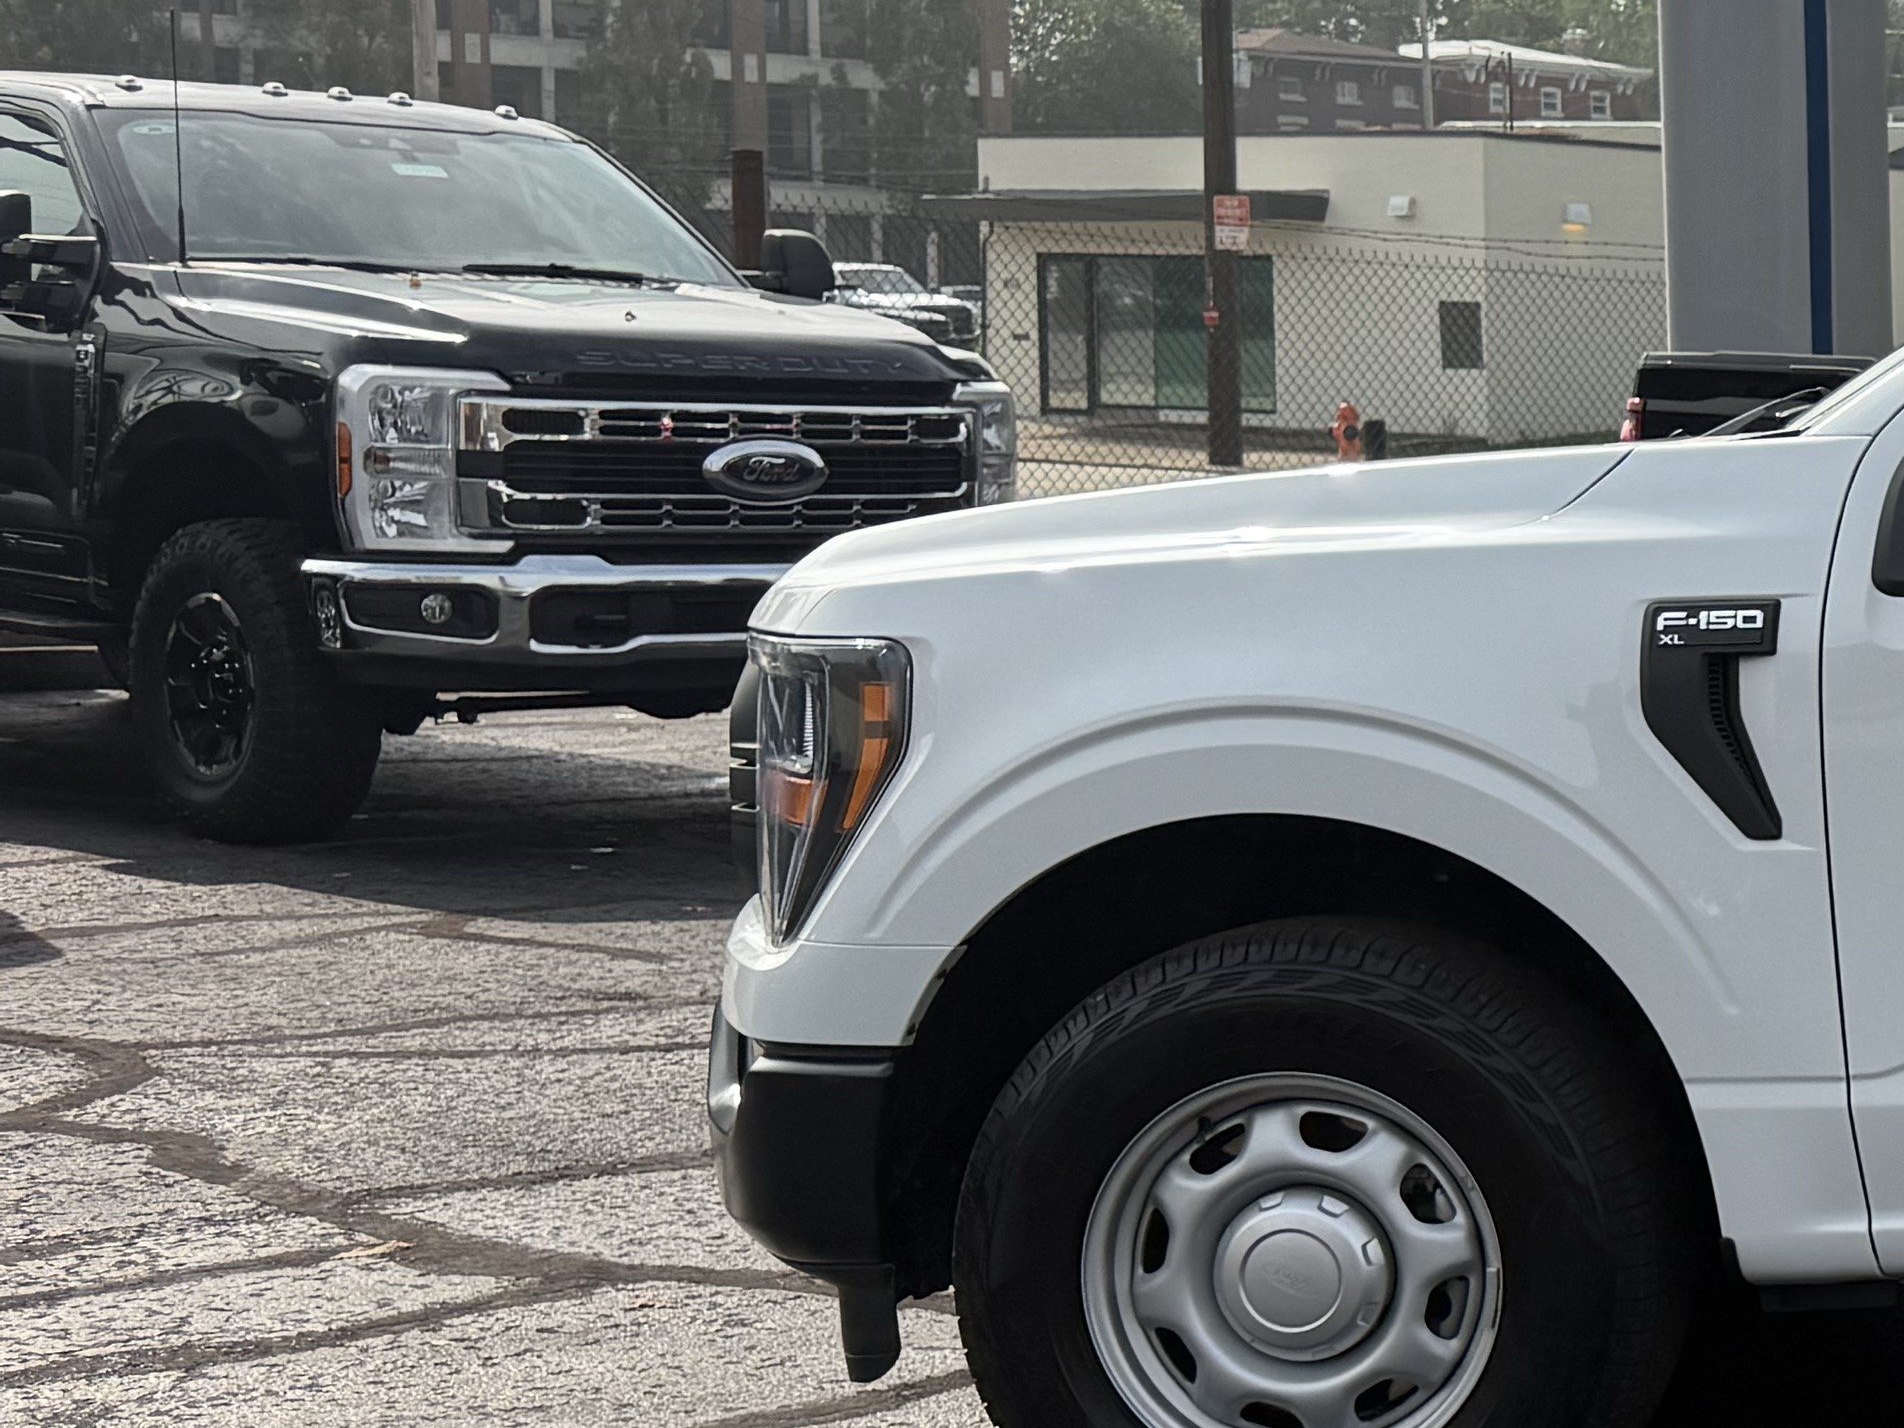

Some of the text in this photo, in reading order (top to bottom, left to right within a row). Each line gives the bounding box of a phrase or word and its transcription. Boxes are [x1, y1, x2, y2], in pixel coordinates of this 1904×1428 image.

[742, 456, 800, 481] Ford
[1656, 609, 1764, 631] F-150
[1658, 634, 1685, 645] XL
